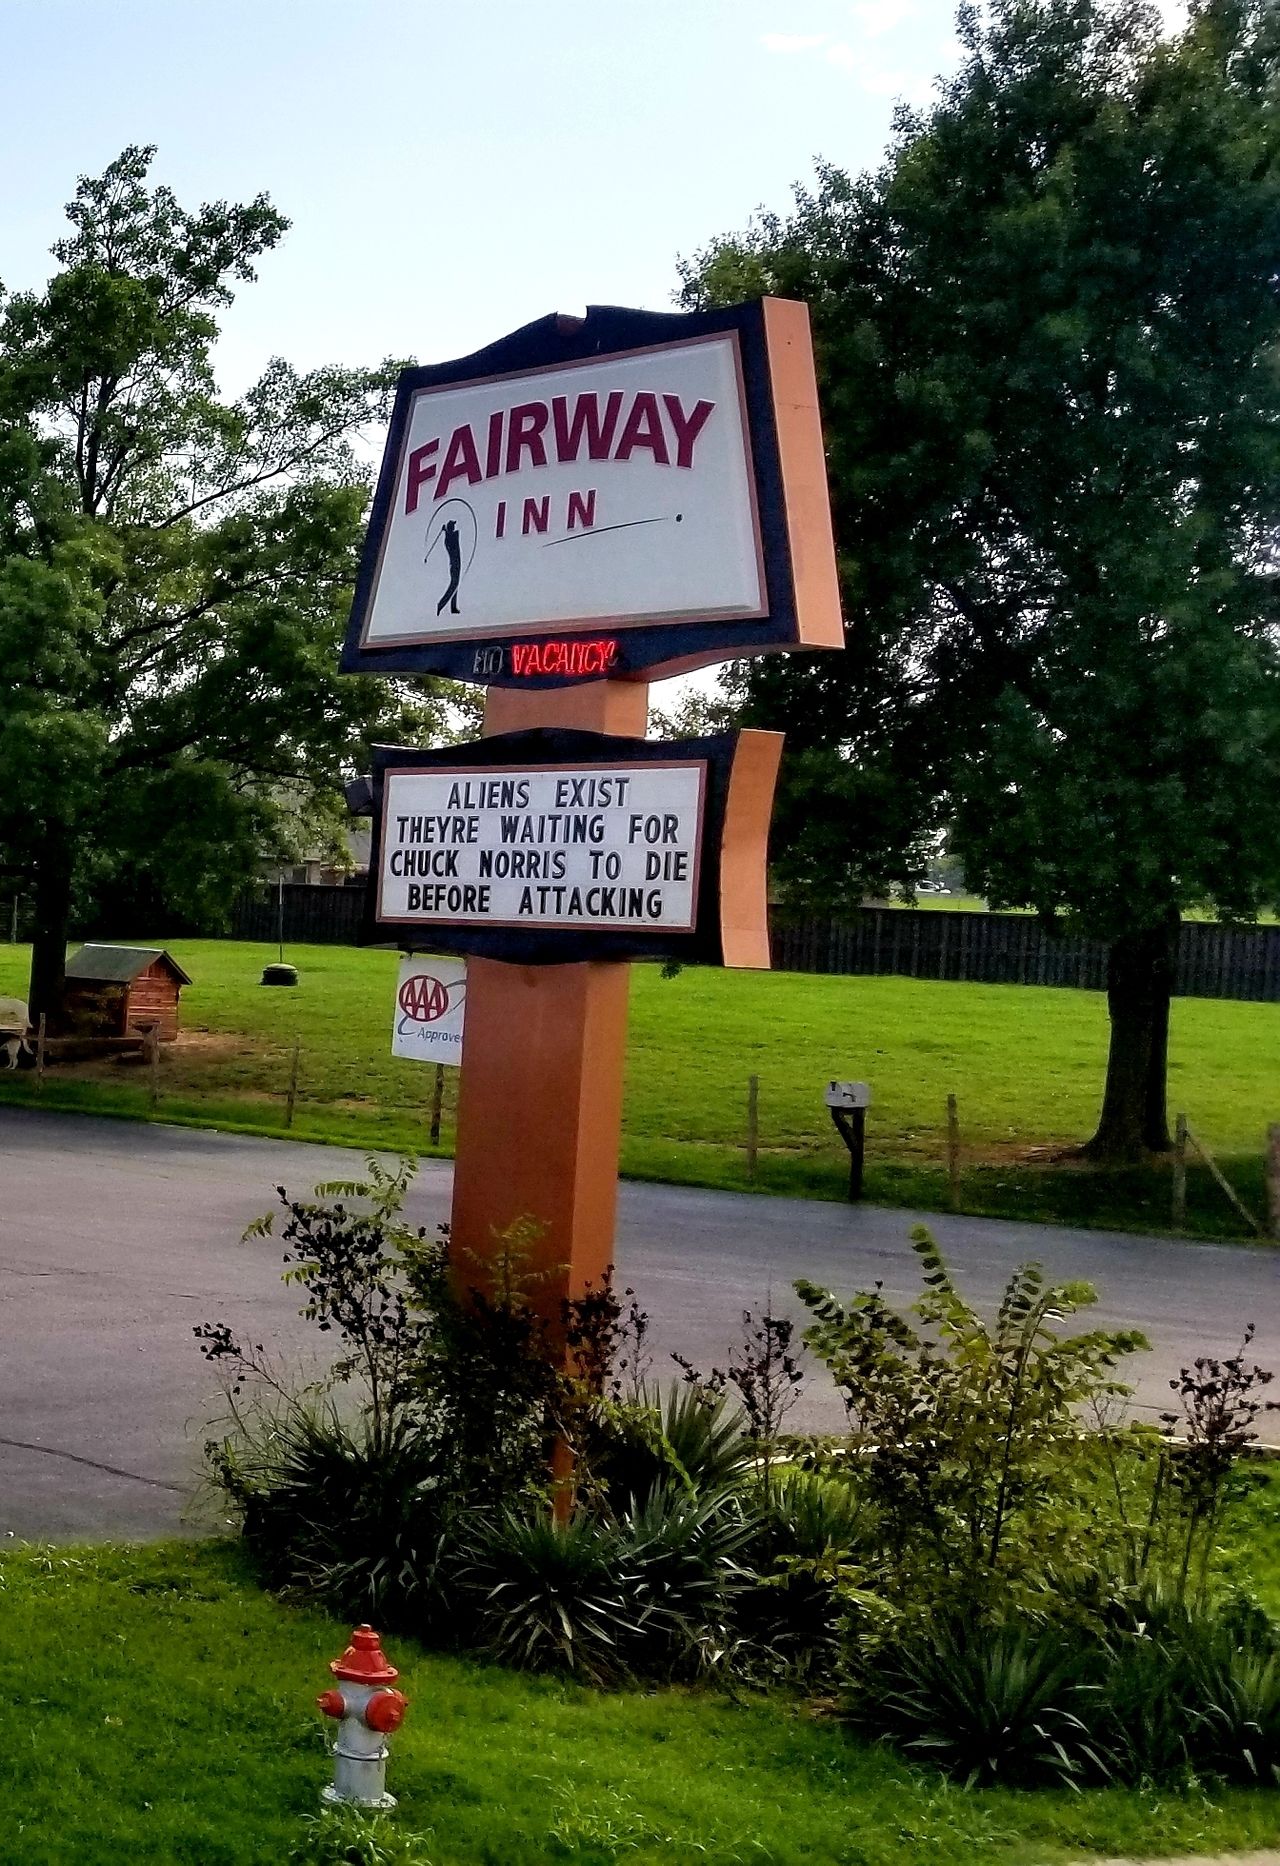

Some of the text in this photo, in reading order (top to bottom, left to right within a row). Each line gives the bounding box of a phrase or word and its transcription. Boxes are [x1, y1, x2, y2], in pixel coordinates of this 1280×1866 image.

[405, 390, 716, 516] FAIRWAY
[496, 489, 597, 538] INN
[473, 640, 618, 675] NO VACANCY
[447, 777, 630, 809] ALIENS EXIST
[396, 814, 679, 844] THEYRE WAITING FOR
[390, 850, 688, 882] CHUCK NORRIS TO DIE
[407, 885, 663, 918] BEFORE ATTACKING
[401, 976, 447, 1021] AAA
[417, 1027, 461, 1043] Approve
